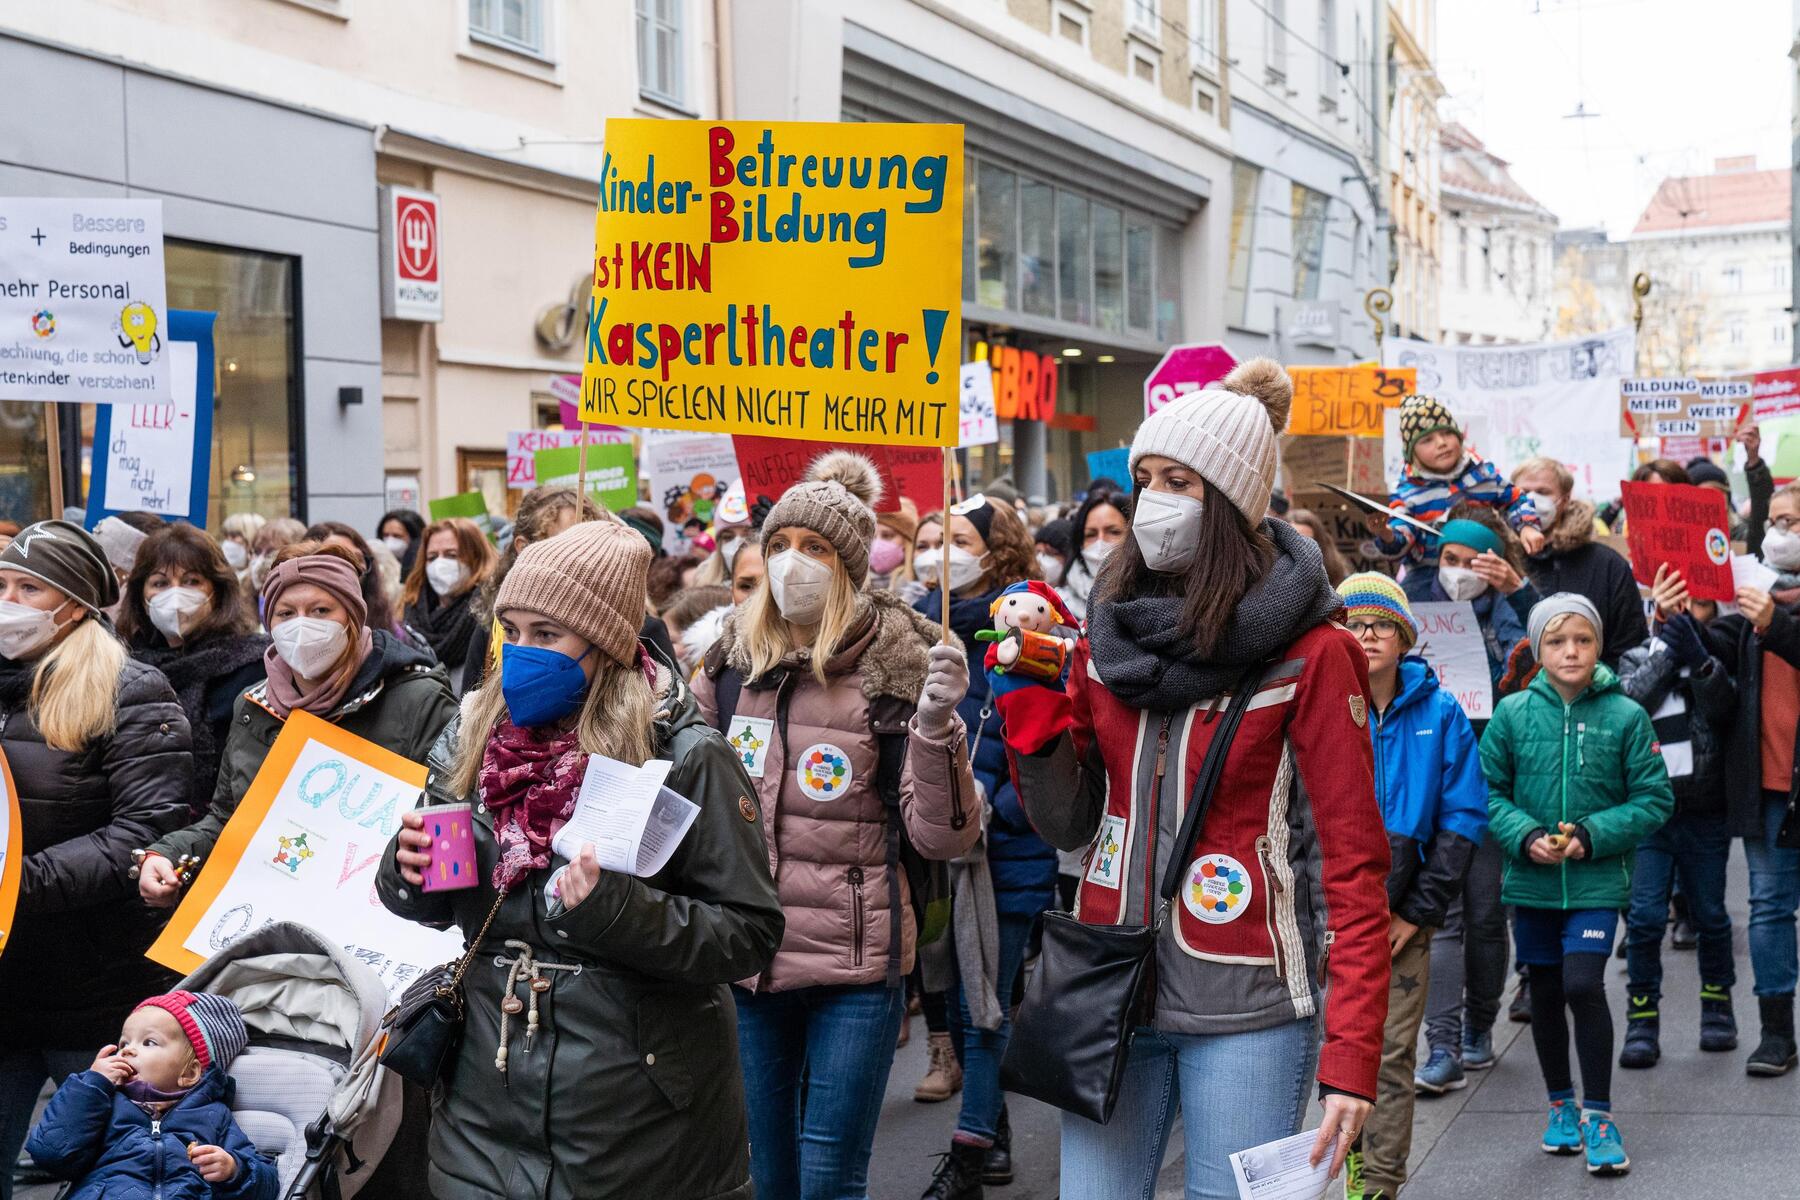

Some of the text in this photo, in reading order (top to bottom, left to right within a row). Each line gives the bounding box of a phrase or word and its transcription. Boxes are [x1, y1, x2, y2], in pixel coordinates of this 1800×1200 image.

[709, 126, 948, 214] Betreuung
[73, 213, 145, 233] Bessere
[710, 191, 886, 268] Bildung
[69, 241, 150, 258] Bedingungen
[631, 241, 711, 293] KEIN
[49, 280, 130, 299] Personal
[0, 341, 134, 365] echnung, die schon
[78, 375, 156, 390] verstehen!
[1623, 381, 1697, 393] BILDUNG
[1701, 384, 1748, 396] MUSS
[585, 377, 619, 415] WIR
[627, 378, 726, 421] SPIELEN
[737, 385, 810, 429] NICHT
[824, 393, 887, 435] MEHR
[895, 398, 947, 439] MIT
[1630, 398, 1737, 418] MEHR WERT
[1658, 420, 1696, 433] SEIN
[1582, 929, 1605, 939] JAKO
